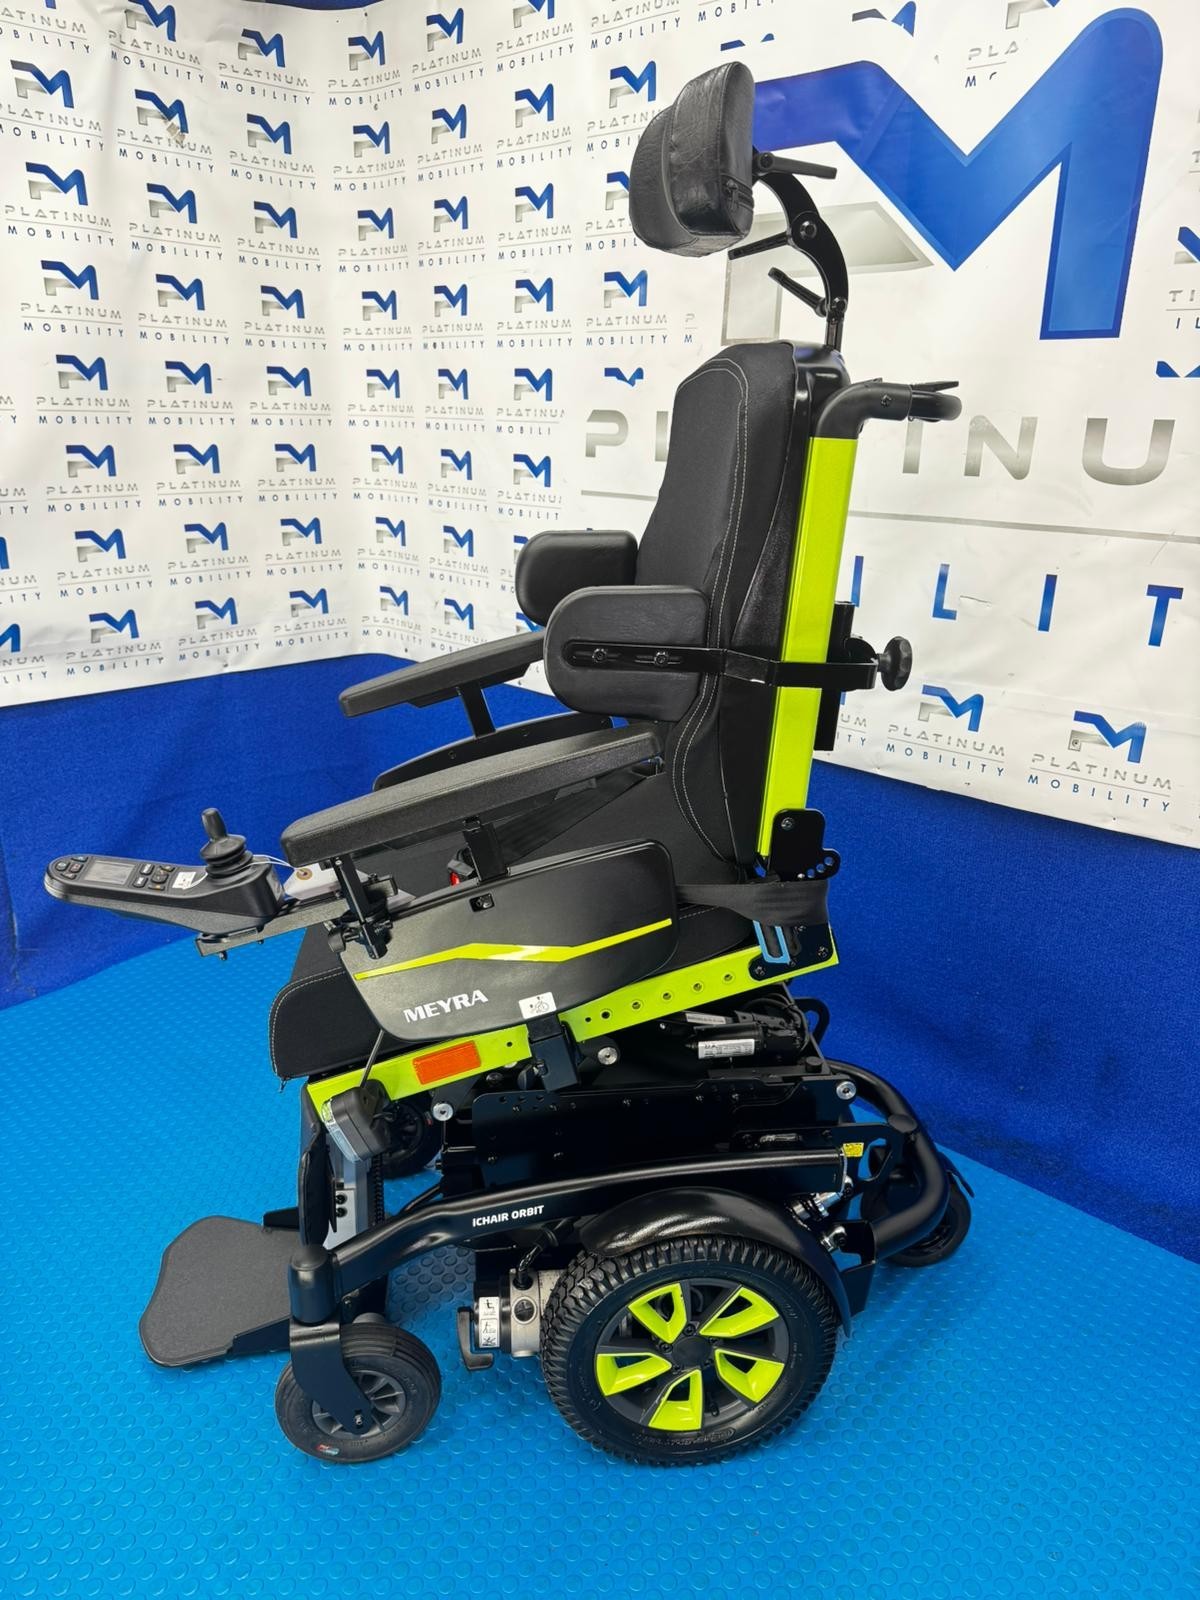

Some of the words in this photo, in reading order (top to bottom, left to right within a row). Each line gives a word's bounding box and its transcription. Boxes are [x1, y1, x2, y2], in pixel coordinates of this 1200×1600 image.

[496, 22, 573, 52] PLATINUM
[591, 17, 680, 49] MOBILITY
[108, 29, 201, 65] PLATINUM
[412, 48, 482, 74] PLATINUM
[497, 44, 573, 72] MOBILITY
[111, 50, 204, 83] MOBILITY
[218, 62, 308, 87] PLATINUM
[328, 69, 400, 88] PLATINUM
[415, 68, 483, 92] MOBILITY
[221, 81, 310, 104] MOBILITY
[329, 88, 402, 105] MOBILITY
[116, 128, 212, 156] PLATINUM
[497, 126, 573, 149] PLATINUM
[119, 148, 213, 173] MOBILITY
[229, 150, 314, 173] PLATINUM
[417, 144, 482, 164] PLATINUM
[497, 146, 571, 168] MOBILITY
[333, 158, 405, 174] PLATINUM
[418, 163, 483, 181] MOBILITY
[231, 169, 316, 190] MOBILITY
[334, 177, 405, 191] MOBILITY
[5, 205, 111, 228] PLATINUM
[8, 225, 114, 246] MOBILITY
[129, 222, 221, 243] PLATINUM
[497, 224, 571, 242] PLATINUM
[237, 237, 319, 256] PLATINUM
[338, 243, 408, 256] PLATINUM
[418, 235, 484, 250] PLATINUM
[132, 241, 222, 260] MOBILITY
[498, 245, 572, 259] MOBILITY
[239, 256, 321, 271] MOBILITY
[339, 262, 408, 272] MOBILITY
[419, 254, 485, 267] MOBILITY
[21, 303, 122, 319] PLATINUM
[138, 313, 227, 328] PLATINUM
[422, 322, 483, 334] PLATINUM
[497, 319, 571, 330] PLATINUM
[586, 314, 667, 327] PLATINUM
[24, 322, 123, 337] MOBILITY
[244, 321, 325, 336] PLATINUM
[343, 326, 411, 335] PLATINUM
[140, 331, 229, 344] MOBILITY
[246, 339, 326, 350] MOBILITY
[423, 341, 484, 349] MOBILITY
[497, 338, 572, 347] MOBILITY
[586, 335, 667, 345] MOBILITY
[344, 343, 412, 351] MOBILITY
[36, 396, 130, 407] PLATINUM
[147, 399, 233, 409] PLATINUM
[250, 401, 331, 413] PLATINUM
[348, 402, 414, 415] PLATINUM
[425, 406, 484, 416] PLATINUM
[39, 416, 131, 424] MOBILITY
[149, 417, 234, 425] MOBILITY
[251, 418, 332, 426] MOBILITY
[349, 420, 415, 428] MOBILITY
[426, 423, 484, 431] MOBILITY
[46, 483, 138, 495] PLATINUM
[156, 480, 240, 491] PLATINUM
[258, 478, 336, 489] PLATINUM
[159, 496, 243, 506] MOBILITY
[259, 493, 337, 502] MOBILITY
[48, 500, 140, 512] MOBILITY
[168, 556, 248, 570] PLATINUM
[265, 549, 342, 563] PLATINUM
[57, 564, 150, 581] PLATINUM
[267, 564, 342, 575] MOBILITY
[170, 571, 250, 585] MOBILITY
[60, 581, 152, 597] MOBILITY
[274, 618, 347, 633] PLATINUM
[178, 628, 257, 648] PLATINUM
[276, 632, 348, 646] MOBILITY
[64, 640, 161, 661] PLATINUM
[179, 643, 259, 661] MOBILITY
[67, 657, 164, 675] MOBILITY
[888, 724, 1005, 757] PLATINUM
[886, 743, 1004, 776] MOBILITY
[1032, 754, 1171, 790] PLATINUM
[1028, 774, 1169, 811] MOBILITY
[403, 990, 488, 1022] MEYRA
[472, 1212, 509, 1228] ICHAIR
[511, 1205, 544, 1220] ORBIT
